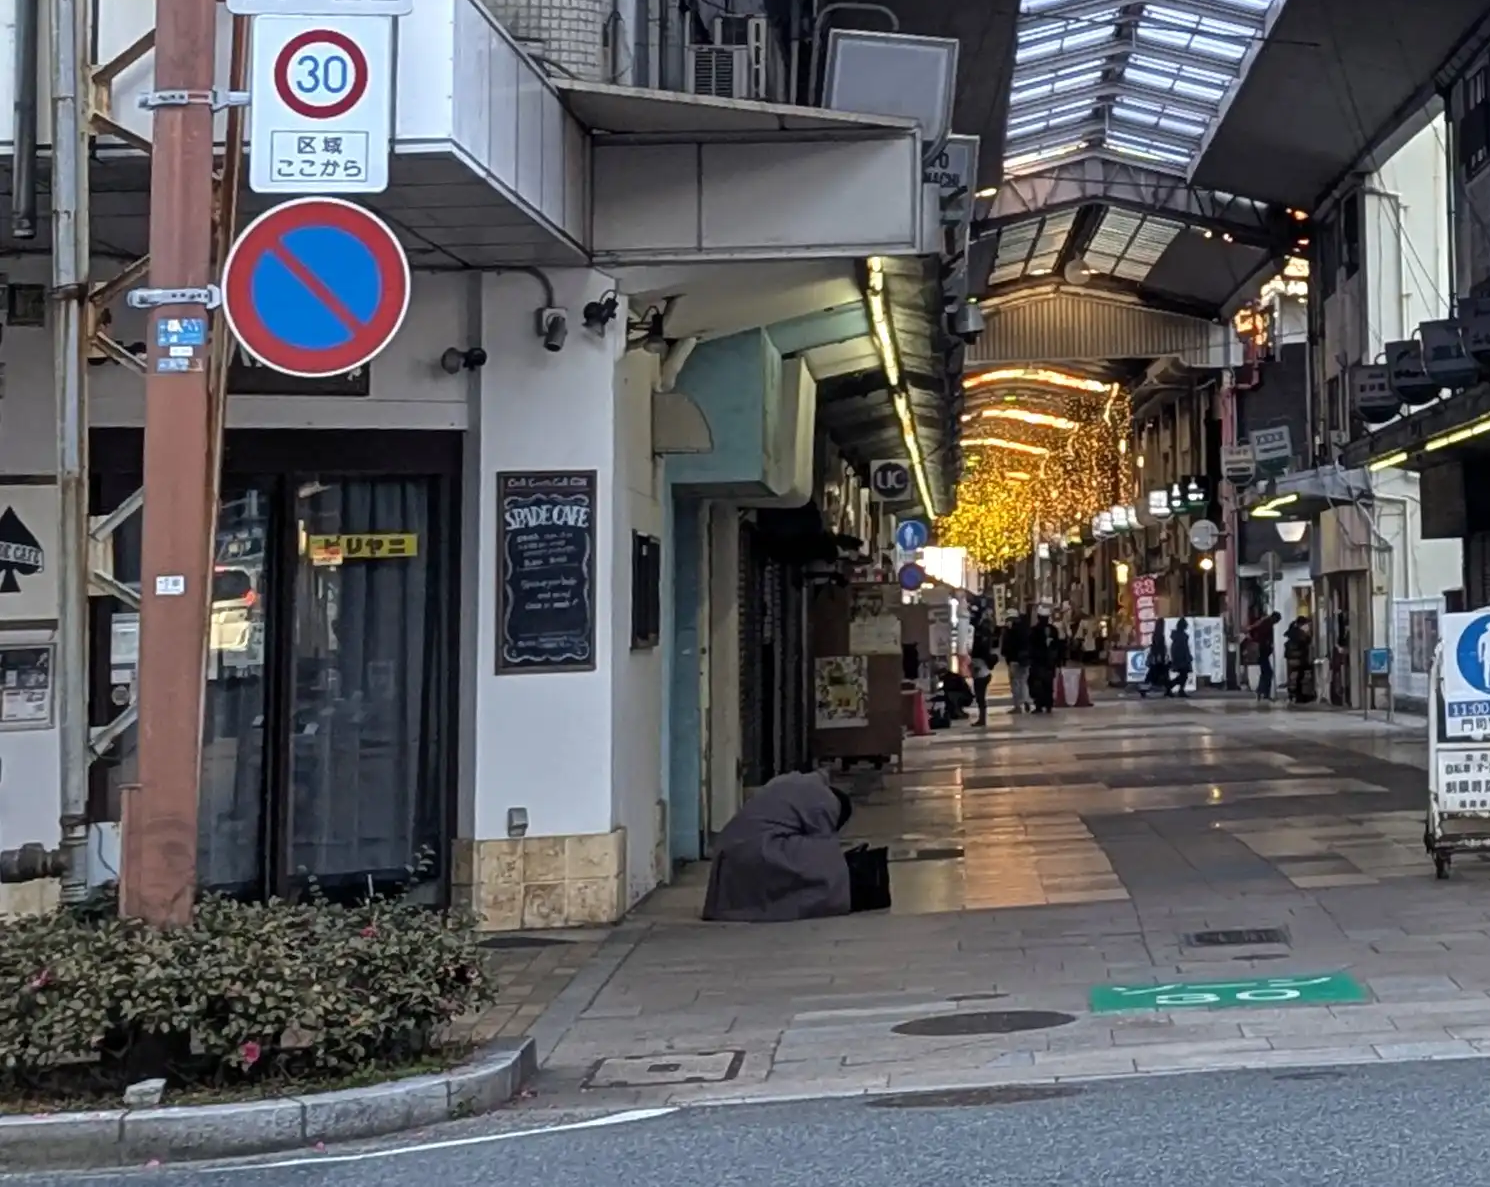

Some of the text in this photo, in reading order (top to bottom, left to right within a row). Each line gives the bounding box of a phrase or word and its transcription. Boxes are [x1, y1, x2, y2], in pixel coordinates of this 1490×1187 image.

[296, 55, 348, 94] 30
[297, 136, 343, 154] 区域
[276, 159, 362, 178] ここから
[552, 503, 590, 527] CAFE
